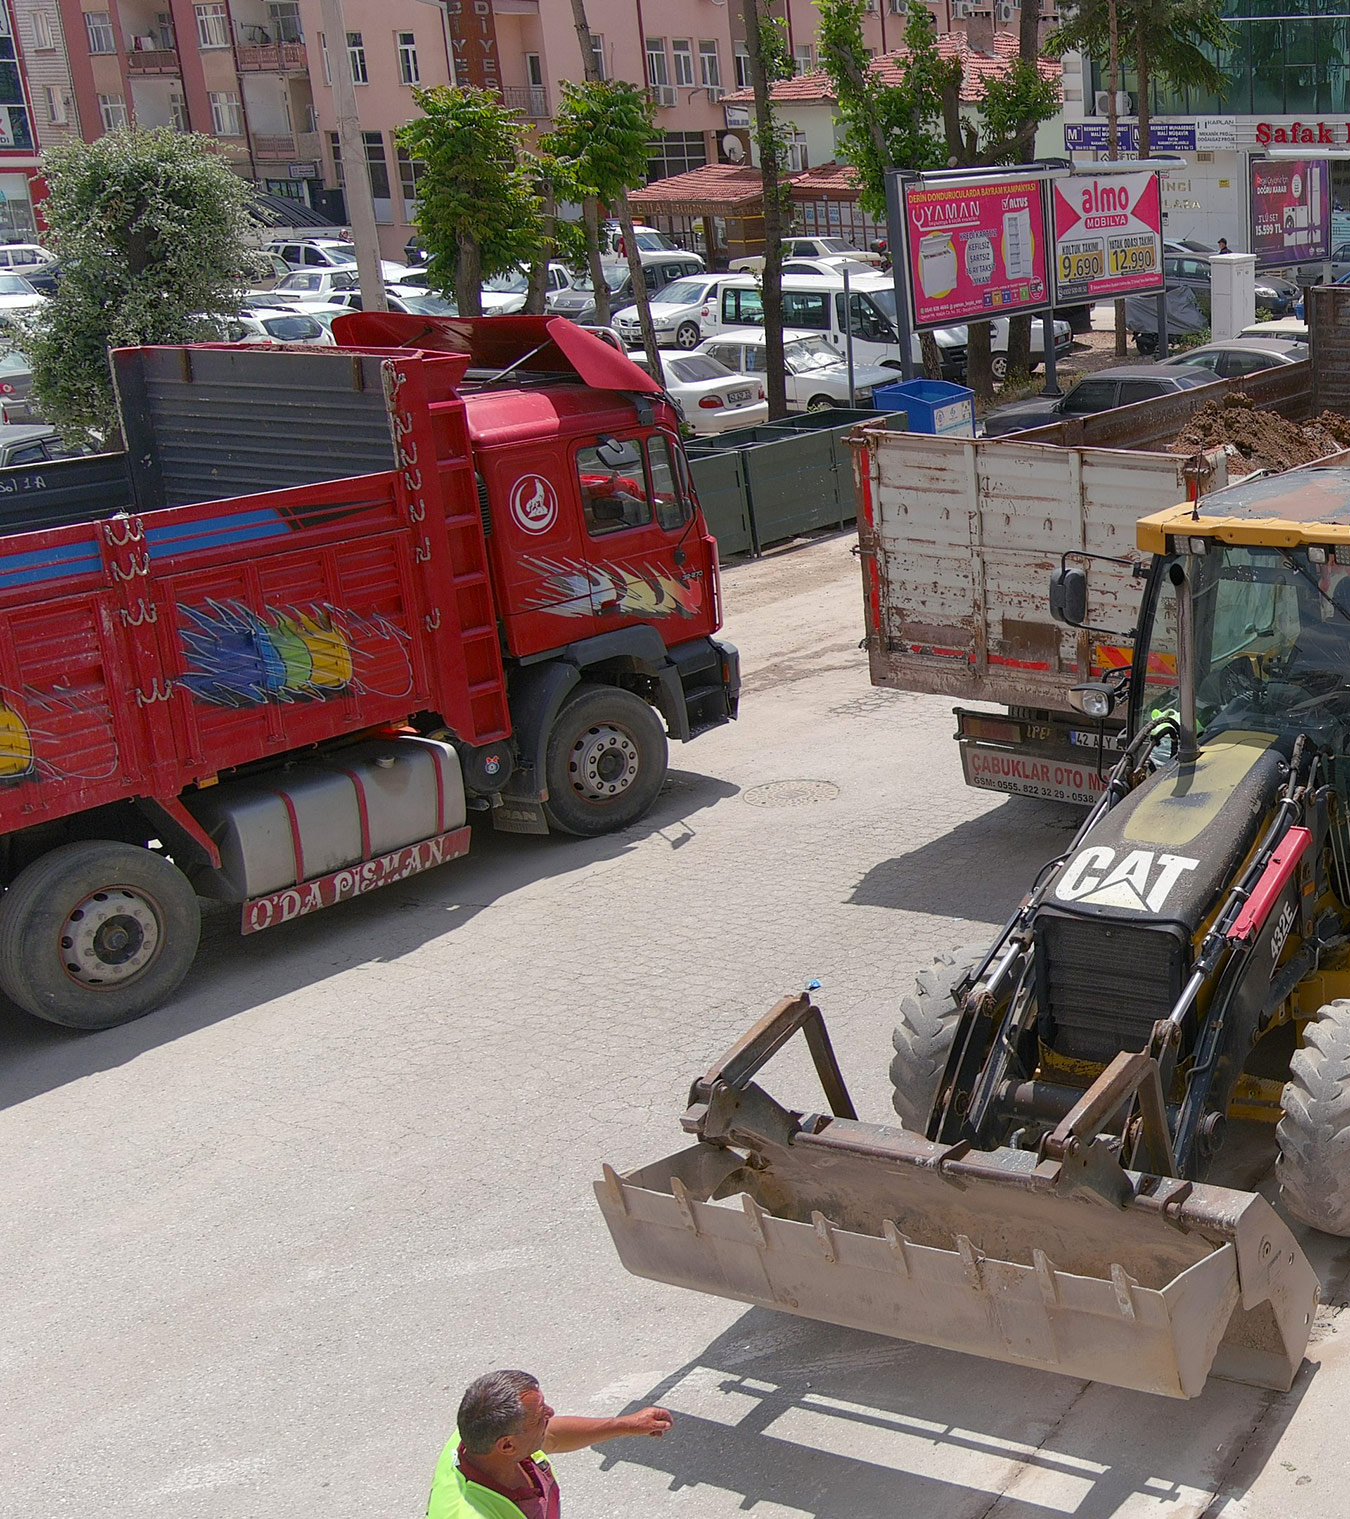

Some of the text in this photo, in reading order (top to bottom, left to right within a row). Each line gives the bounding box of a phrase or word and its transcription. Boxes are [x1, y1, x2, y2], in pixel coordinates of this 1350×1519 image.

[1068, 129, 1078, 140] M
[1255, 122, 1334, 148] Şafak
[908, 183, 1036, 204] DERİN DONDURUCULARDA BAYRAM KAMPANYASI
[1081, 180, 1130, 215] almo
[1257, 184, 1272, 195] DOĞRU
[925, 200, 980, 221] YAMAN
[1009, 197, 1028, 209] ALTUS
[1269, 213, 1279, 221] SET
[1274, 224, 1282, 234] TL
[1061, 242, 1099, 256] KOLTUK TAKIMI
[1109, 235, 1154, 250] YATAK ODASI TAKIMI
[1076, 732, 1089, 746] 42
[971, 753, 1050, 784] ÇABUKLAR
[1054, 767, 1084, 789] OTO
[974, 776, 996, 788] GSM:
[997, 779, 1022, 792] 0555.
[1023, 784, 1039, 796] 822
[1041, 787, 1052, 797] 32
[1054, 789, 1065, 799] 29
[1055, 846, 1201, 913] CAT
[1270, 900, 1294, 959] 432E
